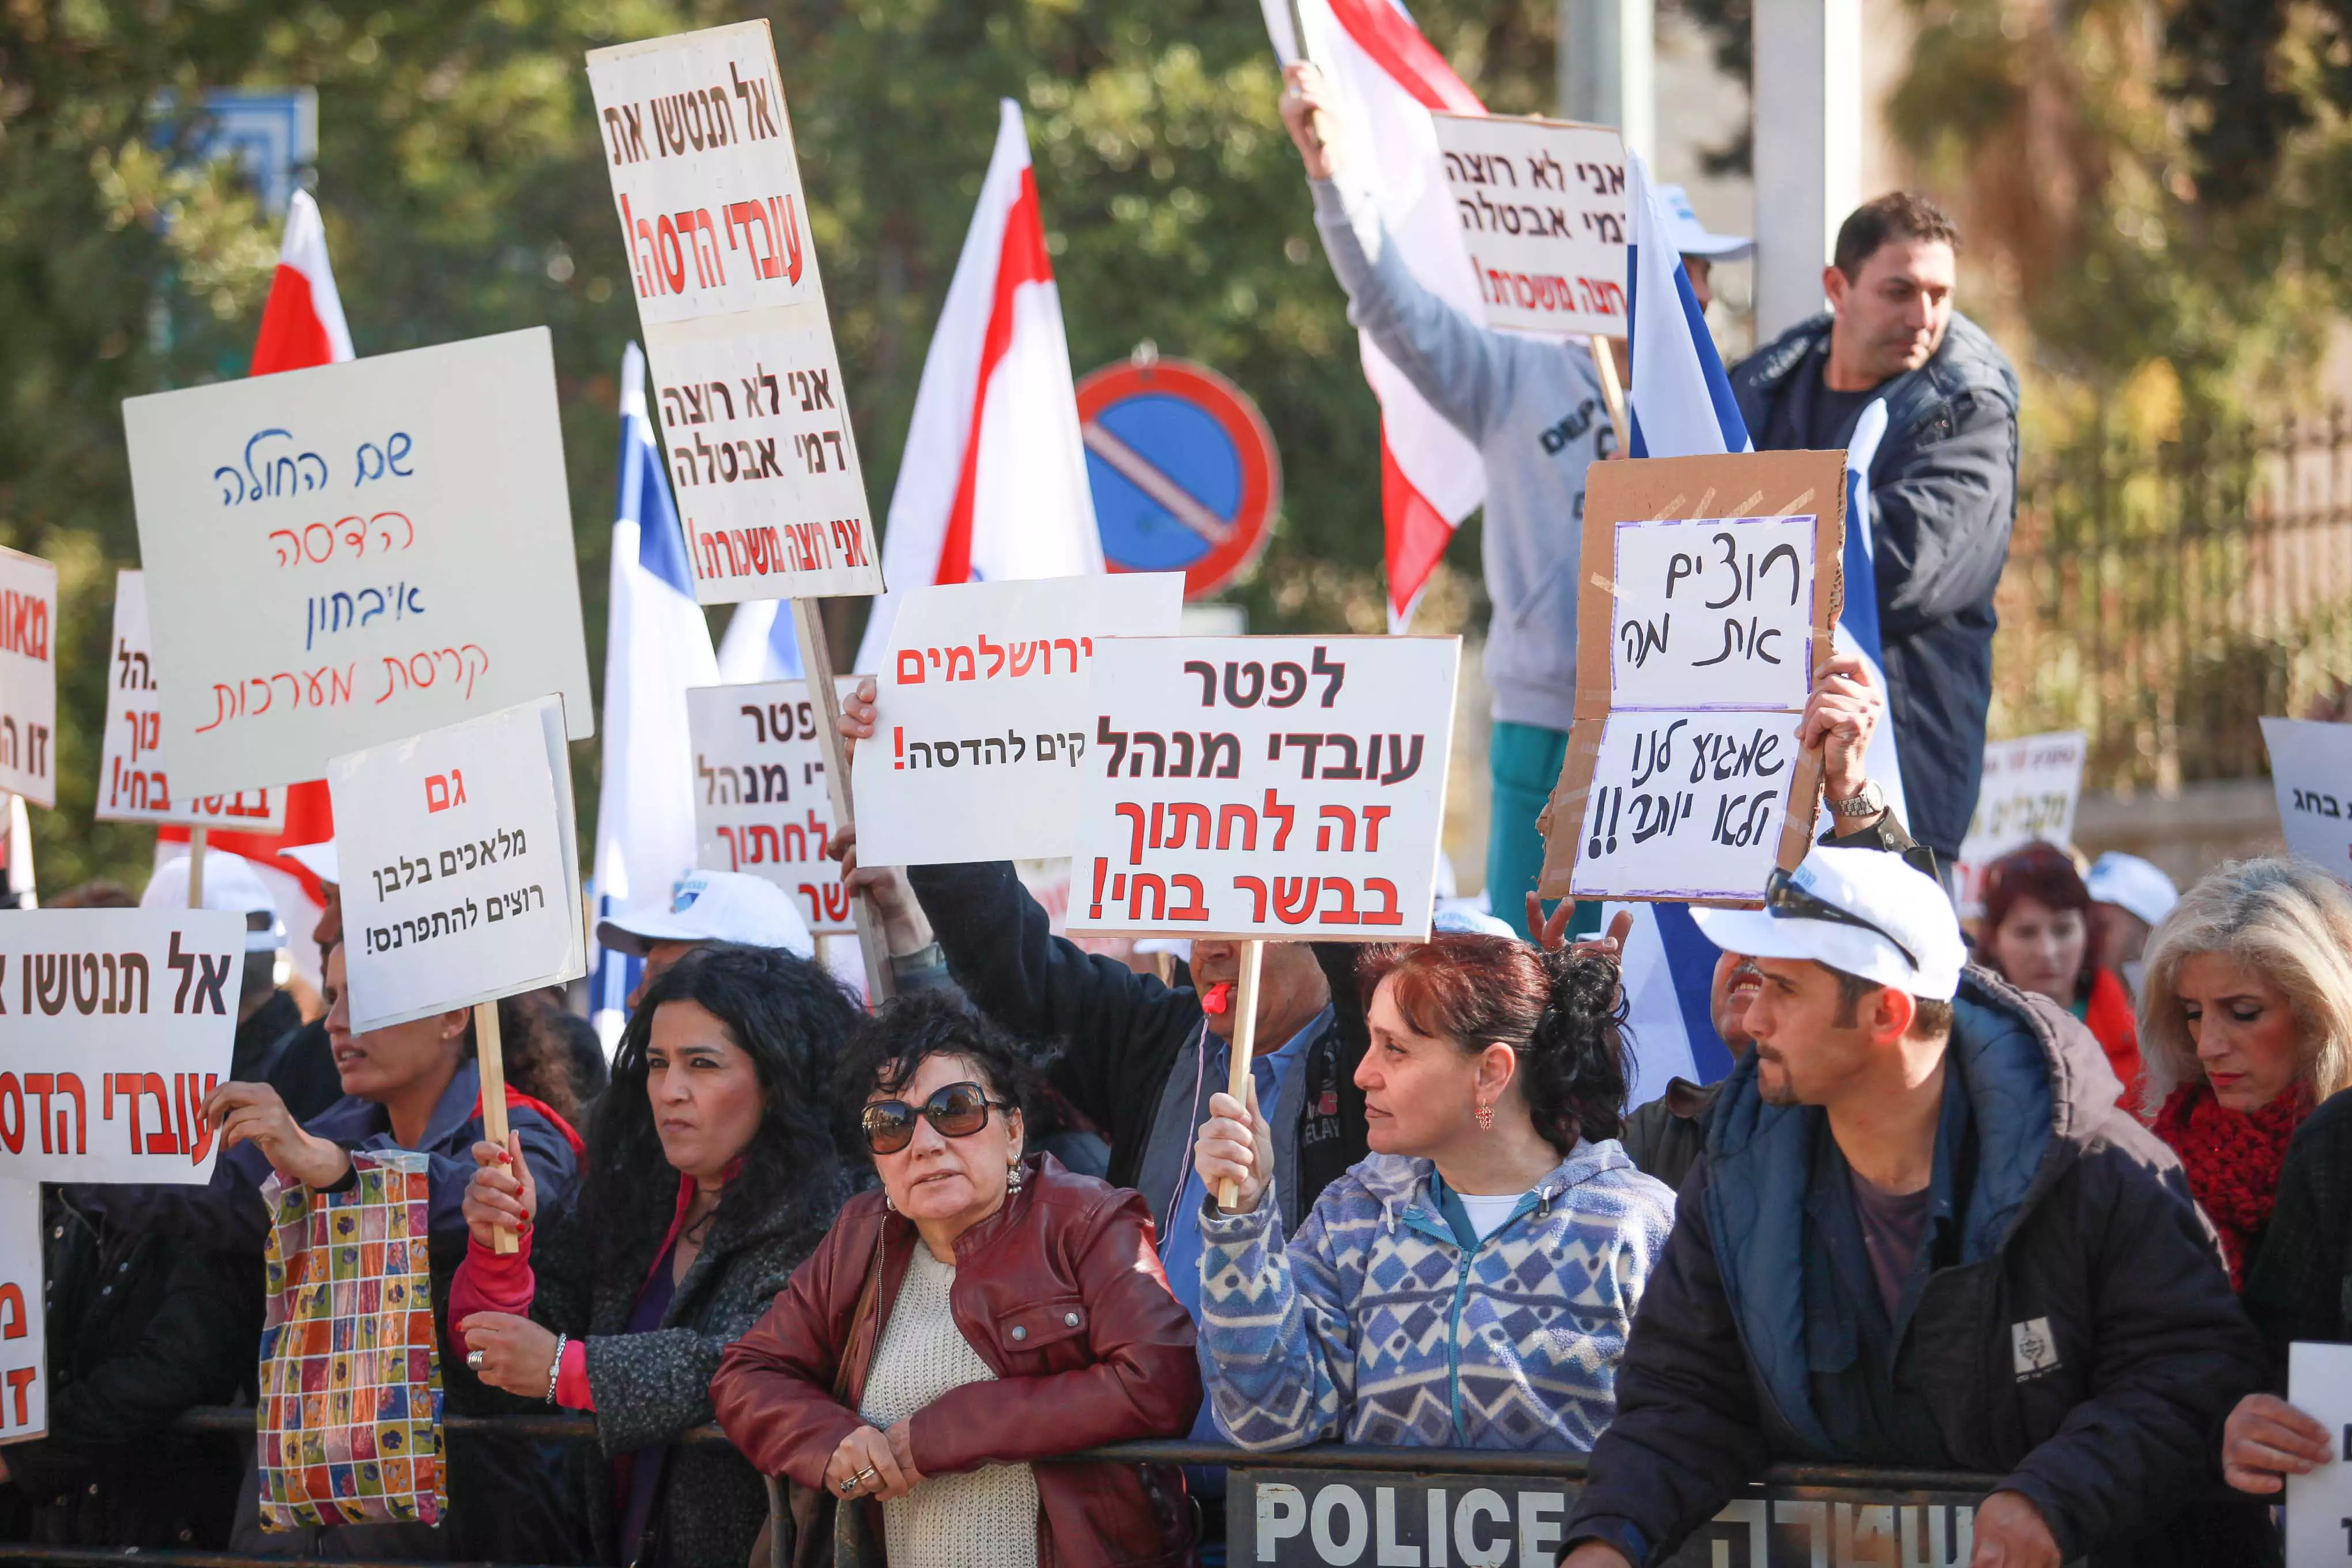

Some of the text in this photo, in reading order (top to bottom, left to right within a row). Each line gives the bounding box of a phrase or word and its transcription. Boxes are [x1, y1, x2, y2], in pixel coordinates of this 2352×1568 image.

[603, 61, 779, 166] אל תנטשו את
[1444, 148, 1625, 196] אני לא רוצה
[620, 193, 803, 298] עובדי הדסה!
[1457, 190, 1627, 244] מי אבטלה
[661, 361, 835, 427] אני לא רוצה
[213, 427, 414, 507] שם החולה
[674, 430, 846, 489] דמי אבטלה
[269, 510, 414, 567] הדסה
[688, 517, 869, 579] אני רוצה משכורת!
[1665, 533, 1800, 609] רוצים
[0, 587, 48, 661] מאו
[304, 581, 425, 651] איבחון
[1620, 612, 1782, 668] את מה
[194, 644, 489, 733] קריסת מערכות
[896, 634, 1092, 685] ירושלמים
[1183, 646, 1346, 709] לפטר
[0, 715, 50, 778] זו ה
[741, 701, 819, 745] פטר
[894, 727, 1085, 770] קים להדסה!
[1096, 715, 1425, 787] עובדי מנהל
[1631, 718, 1785, 789] שמגיע לנו
[111, 756, 171, 811] בחי!
[425, 768, 466, 813] גם
[698, 754, 789, 806] מנהל
[2292, 787, 2341, 819] בחג
[717, 809, 828, 872] לחתוך
[1114, 788, 1392, 866] זה לחתוך
[1711, 789, 1778, 848] ולא
[372, 827, 527, 903] מלאכים בלבן
[1088, 856, 1209, 922] בחי!
[365, 883, 545, 955] רוצים להתפרנס!
[1232, 875, 1404, 926] בבשר
[22, 952, 149, 1015] תנטשו
[168, 930, 231, 1015] אל
[0, 1072, 218, 1166] עובדי הדס
[1256, 1483, 1565, 1568] POLICE
